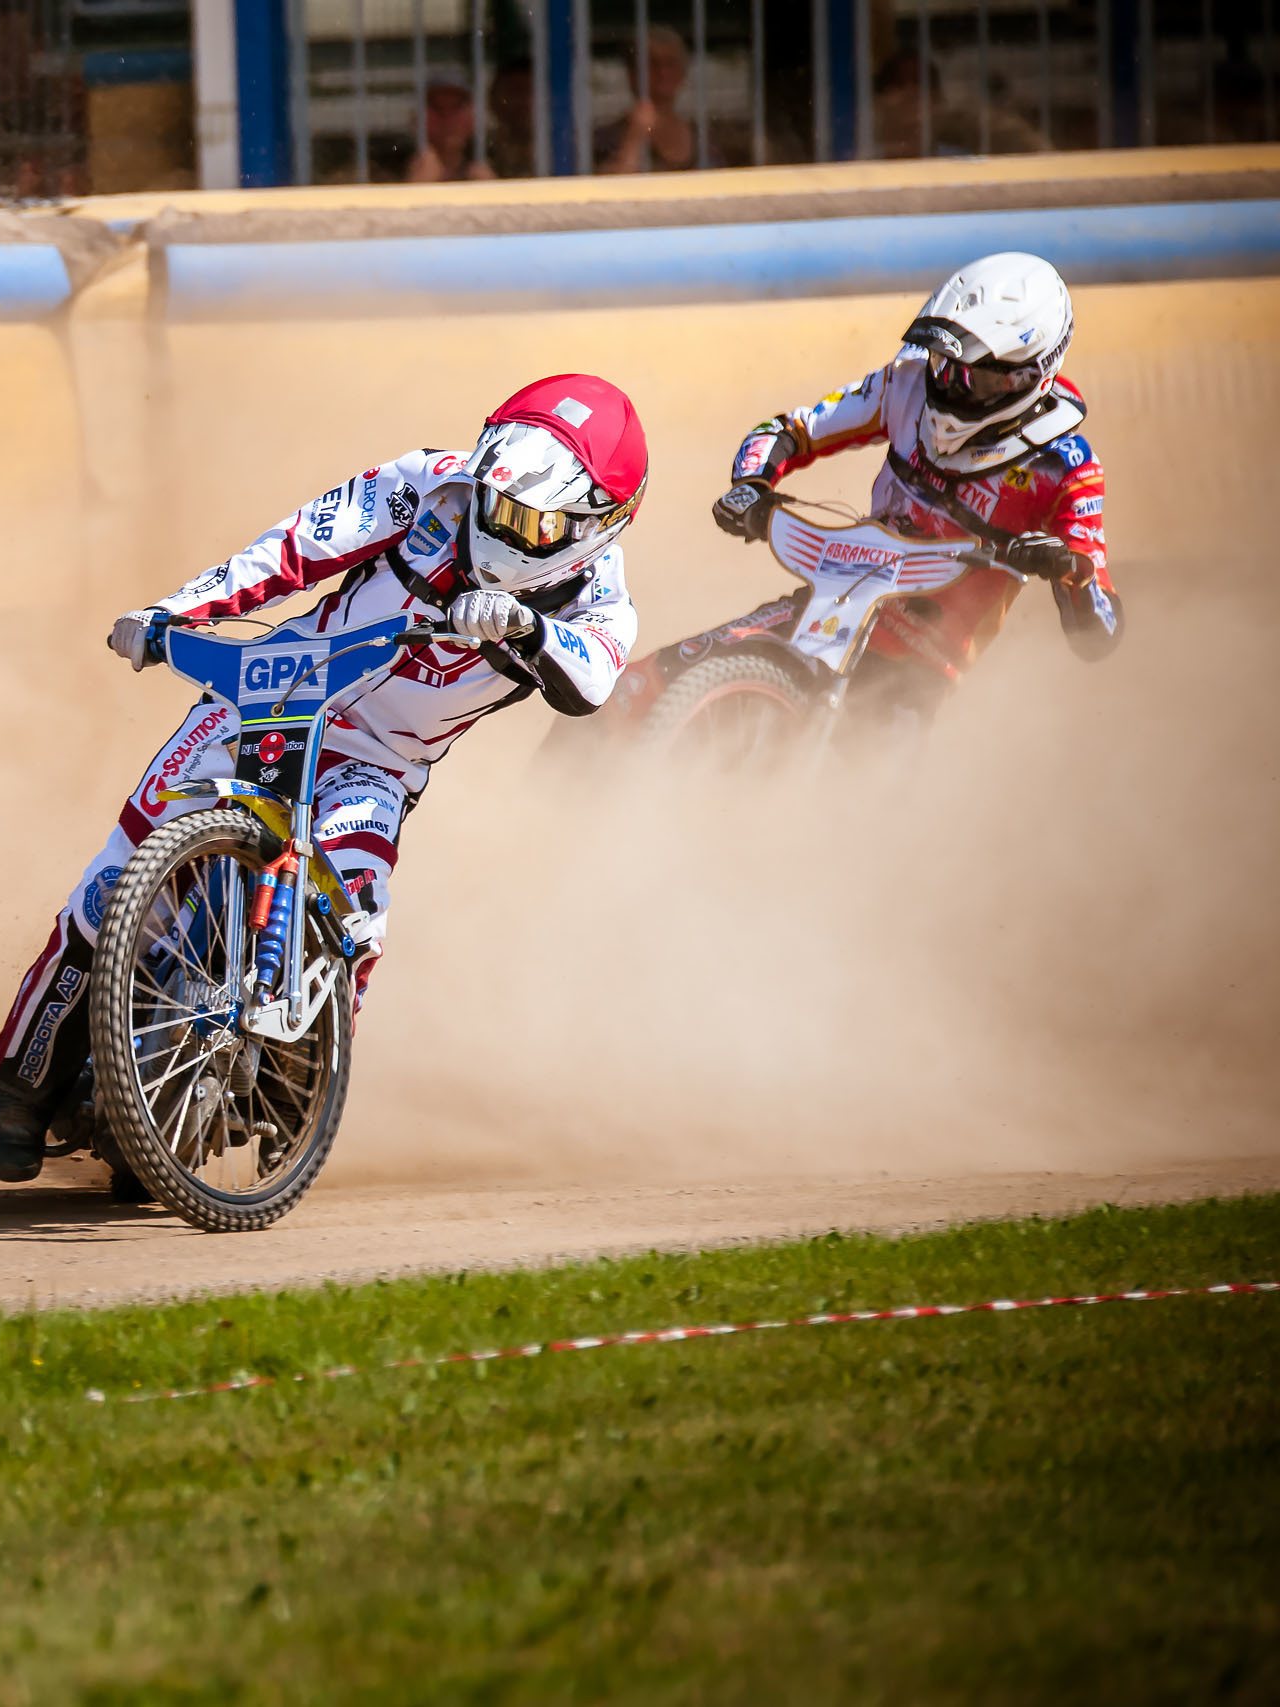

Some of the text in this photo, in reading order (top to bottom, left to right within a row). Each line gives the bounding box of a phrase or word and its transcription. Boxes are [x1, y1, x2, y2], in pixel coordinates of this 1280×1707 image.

[357, 478, 377, 534] EUROLINK
[825, 542, 901, 568] ABRAMCZYK
[553, 623, 590, 664] GPA
[245, 654, 320, 692] GPA
[341, 795, 396, 815] EUROLINK
[18, 965, 82, 1084] ROBOTA AB
